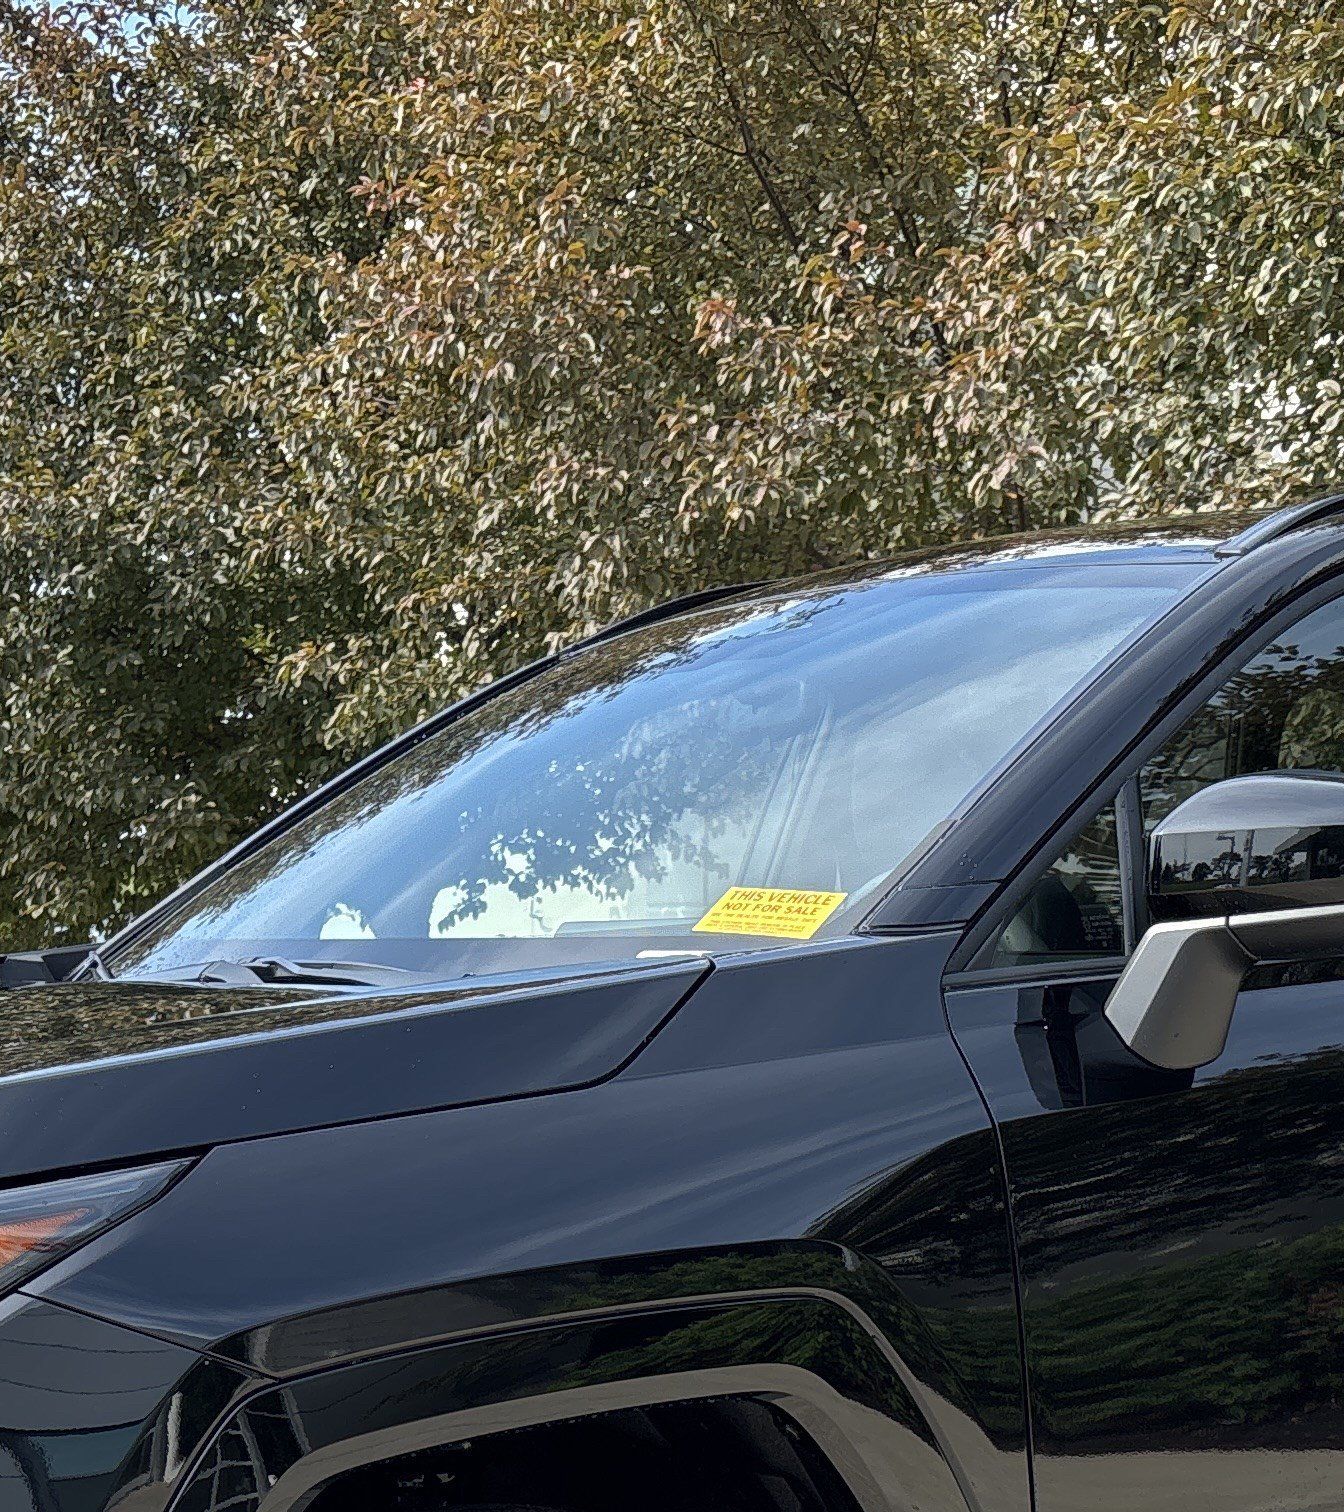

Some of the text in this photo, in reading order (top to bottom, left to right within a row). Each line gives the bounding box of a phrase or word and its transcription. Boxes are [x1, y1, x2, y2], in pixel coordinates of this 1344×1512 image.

[730, 890, 836, 906] THIS VEHICLE
[722, 902, 822, 916] NOT FOR SALE
